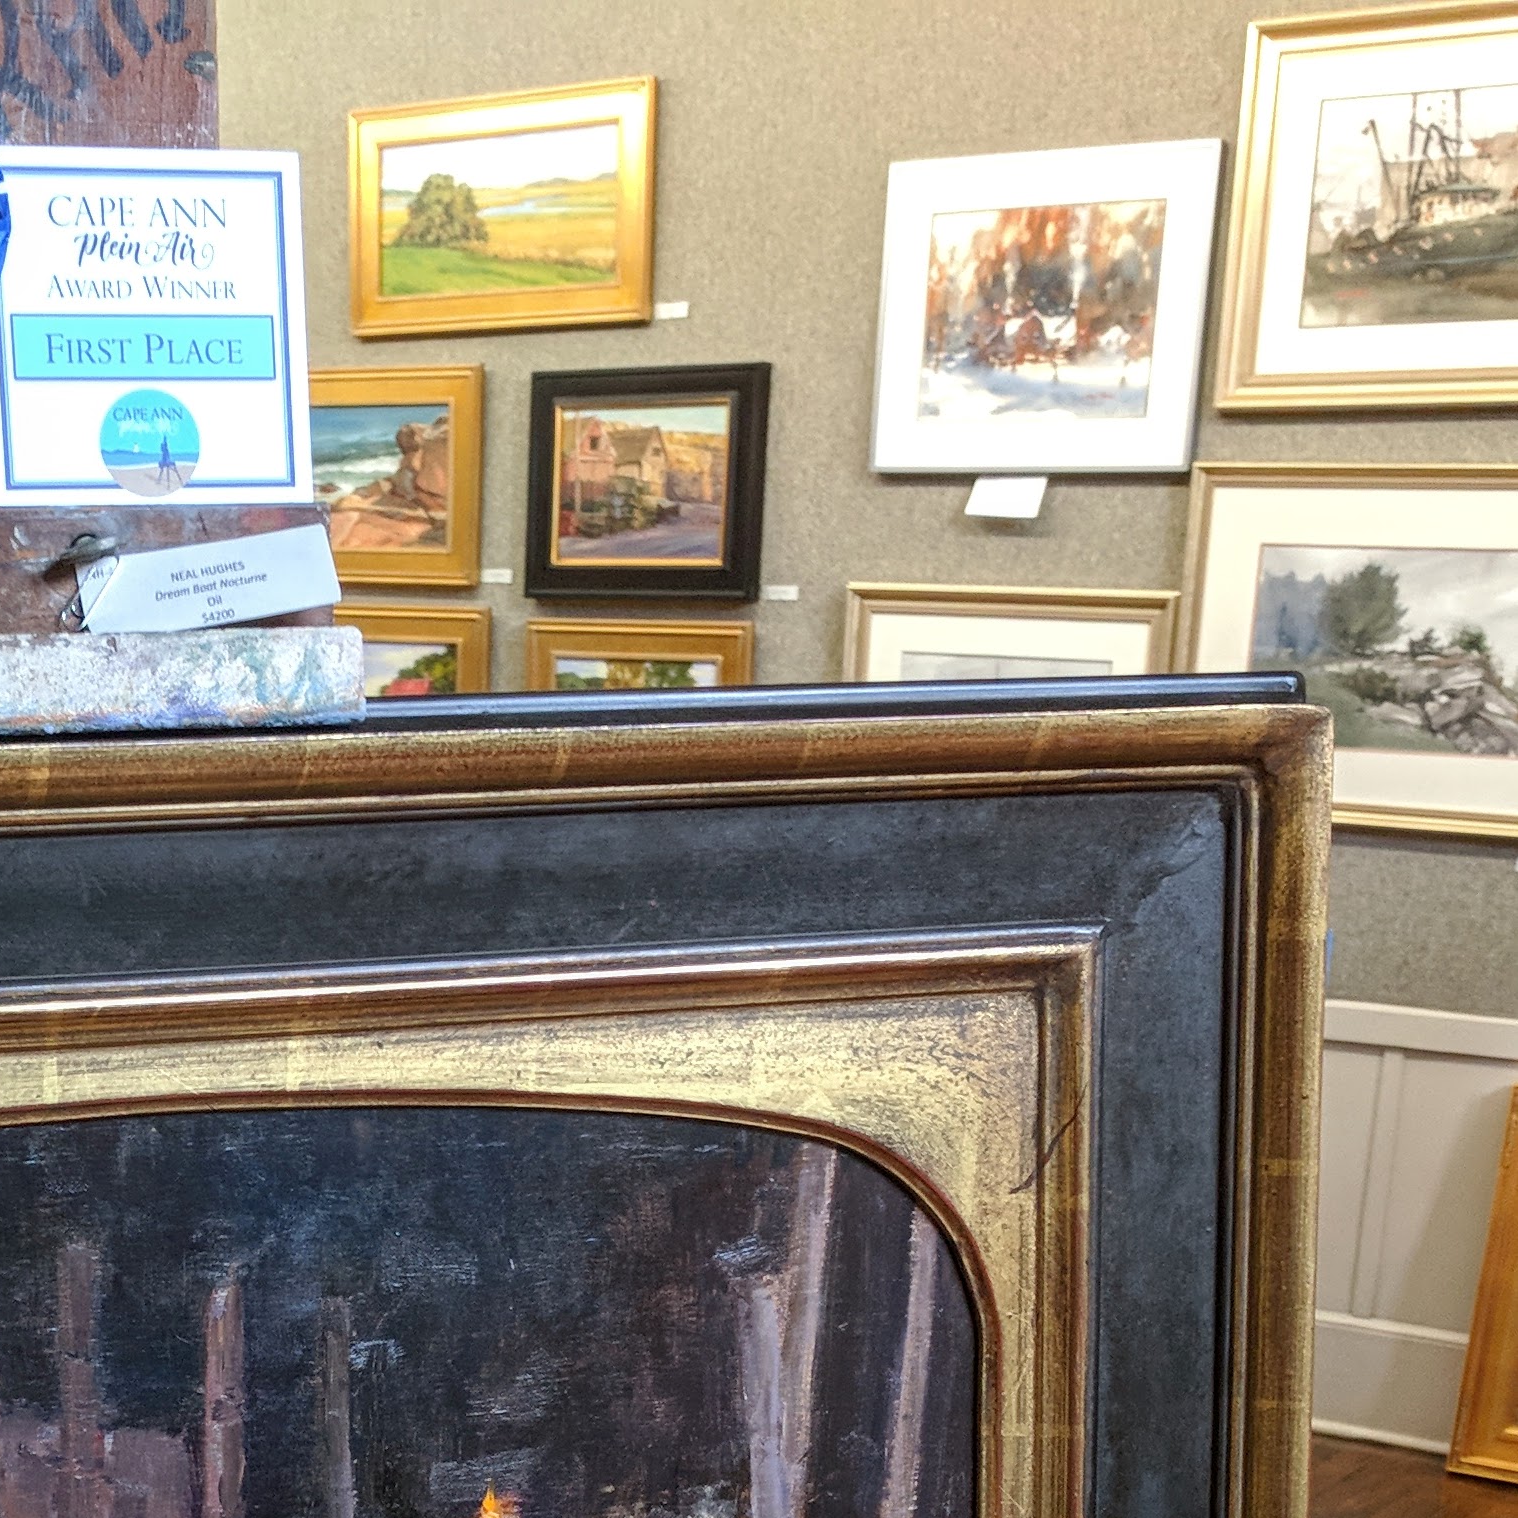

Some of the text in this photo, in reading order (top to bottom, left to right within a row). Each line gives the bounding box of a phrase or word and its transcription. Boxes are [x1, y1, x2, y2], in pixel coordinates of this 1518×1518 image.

[48, 195, 226, 228] CAPE ANN
[153, 231, 215, 270] Air
[48, 274, 237, 299] AWARD WINNER
[45, 333, 243, 364] FIRST PLACE
[112, 407, 183, 422] CAPE ANN
[170, 560, 246, 583] NEAL HUGHES
[155, 573, 268, 602] Dream Boat Nocturne
[207, 595, 223, 607] Oil
